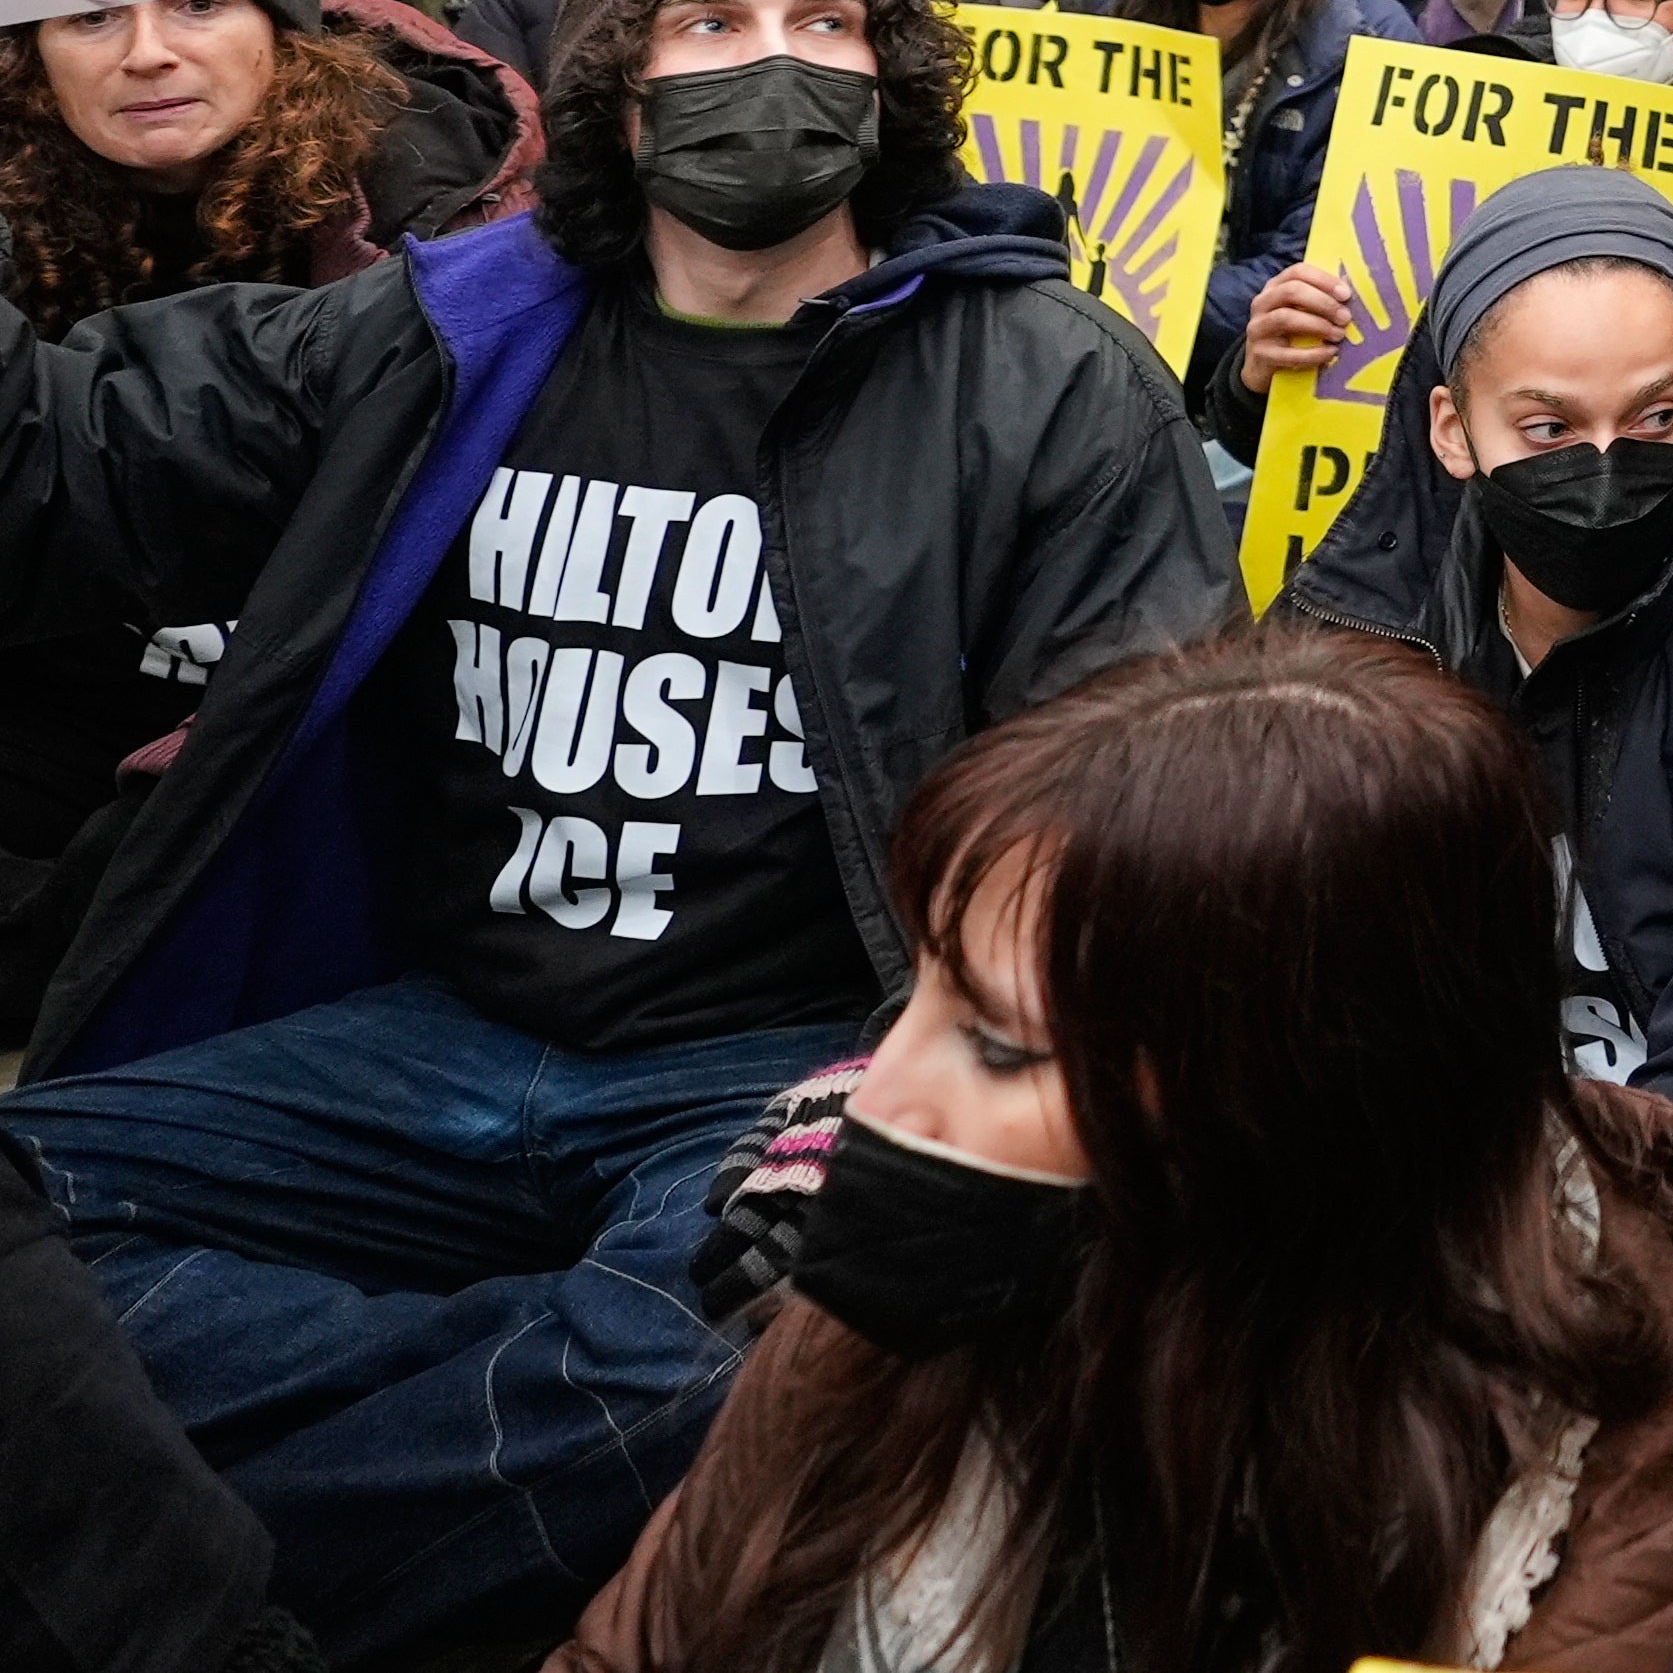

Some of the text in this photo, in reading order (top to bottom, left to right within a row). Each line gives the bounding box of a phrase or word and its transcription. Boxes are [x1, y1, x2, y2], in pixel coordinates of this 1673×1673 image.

[958, 24, 1193, 107] OR THE
[1370, 64, 1515, 148] FOR
[468, 466, 783, 643] HILTO
[489, 804, 682, 941] ICE
